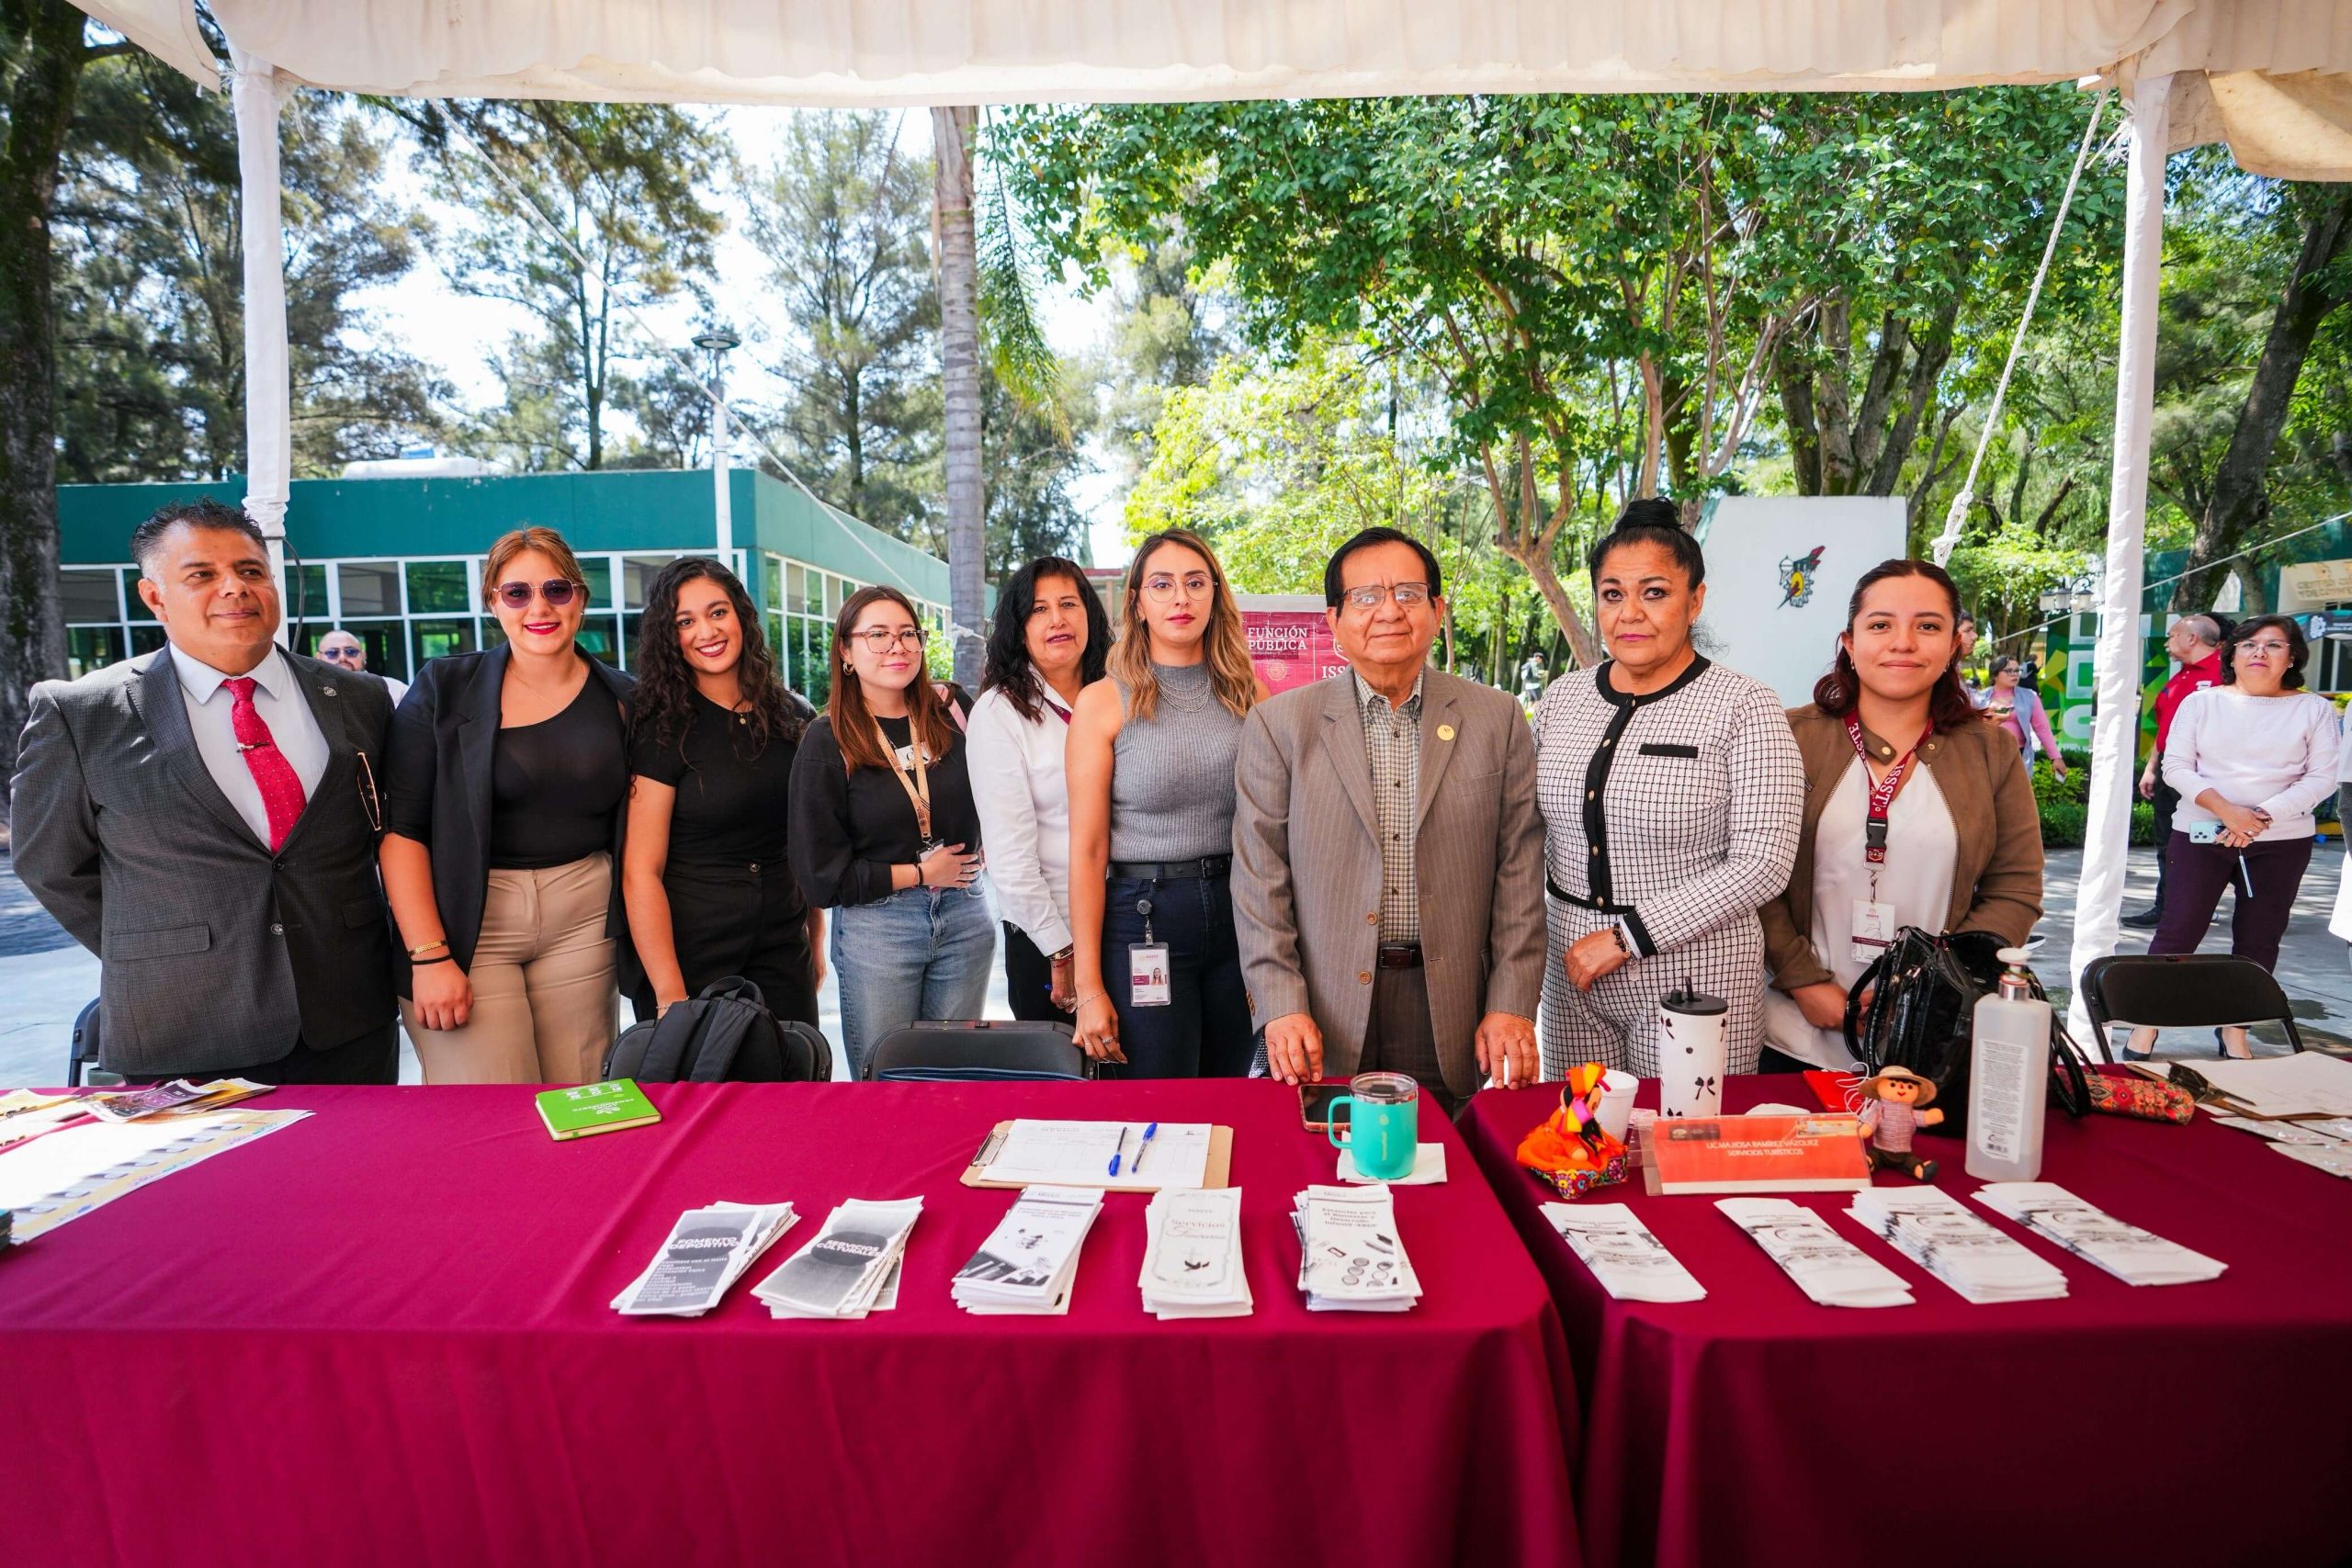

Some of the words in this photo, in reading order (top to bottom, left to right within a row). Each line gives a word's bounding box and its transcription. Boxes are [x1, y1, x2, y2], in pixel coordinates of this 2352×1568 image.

[1248, 626, 1308, 638] FUNCIÓN
[1248, 637, 1308, 650] PÚBLICA
[1321, 665, 1347, 679] ISS
[1171, 1219, 1226, 1228] Servicios
[670, 1241, 740, 1250] DEPORTIVO
[677, 1236, 737, 1245] FOMENTO
[826, 1239, 879, 1251] SERVICIOS
[816, 1242, 884, 1258] CULTURALES
